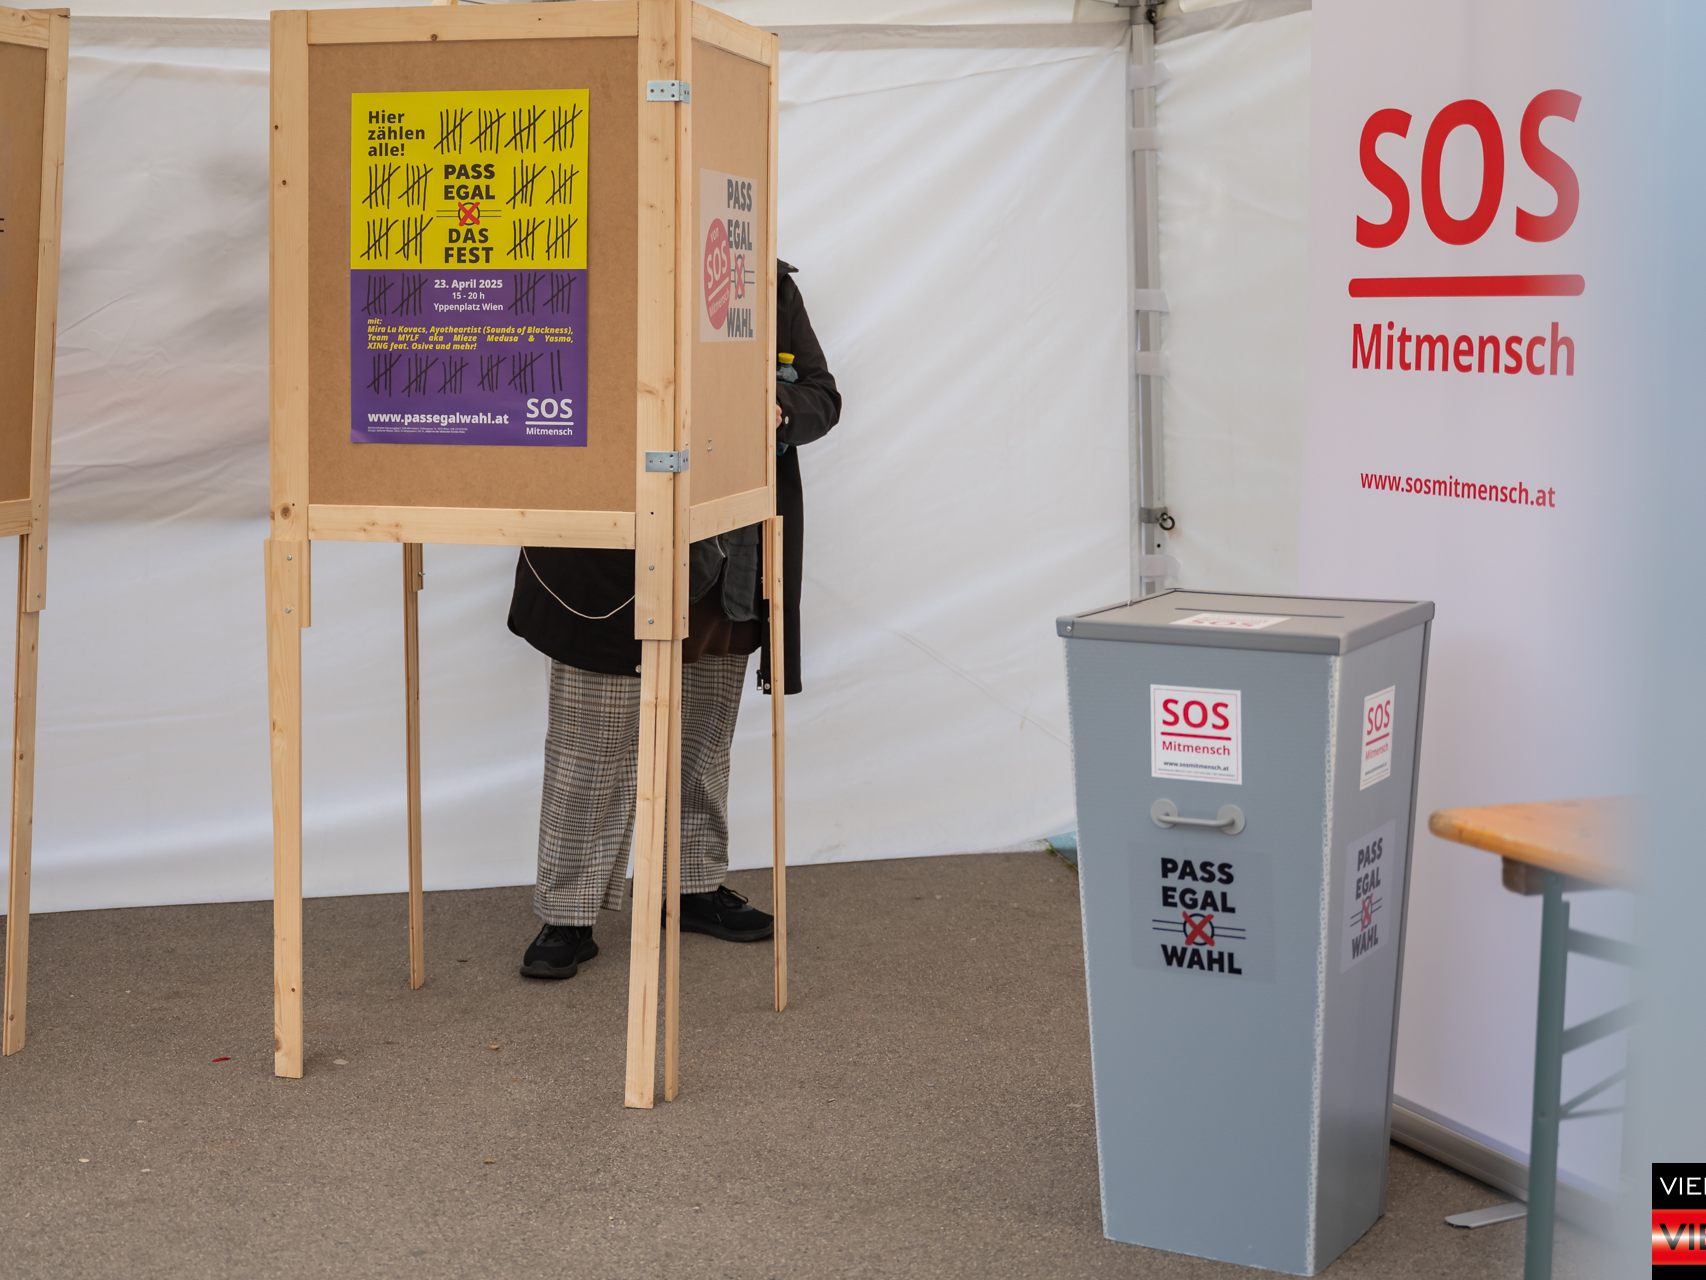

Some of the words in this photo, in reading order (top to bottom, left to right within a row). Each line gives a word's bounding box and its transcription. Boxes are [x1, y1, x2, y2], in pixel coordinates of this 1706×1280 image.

[368, 110, 405, 124] Hier
[367, 126, 425, 140] zählen
[368, 142, 405, 157] alle!
[444, 163, 496, 180] PASS
[1355, 88, 1583, 249] SOS
[443, 184, 496, 201] EGAL
[727, 178, 753, 212] PASS
[448, 228, 489, 244] DAS
[727, 219, 753, 251] EGAL
[444, 247, 494, 264] FEST
[706, 240, 728, 289] SOS
[434, 279, 449, 289] 23.
[451, 278, 477, 291] April
[479, 279, 503, 289] 2025
[452, 292, 462, 300] 15
[468, 292, 478, 300] 20
[479, 291, 485, 300] h
[433, 302, 481, 313] Yppenplatz
[482, 302, 504, 311] Wien
[398, 326, 428, 334] Kovacs,
[430, 326, 482, 335] Ayotheartist
[482, 326, 515, 335] (Sounds
[516, 326, 526, 335] of
[527, 326, 574, 335] Blackness),
[726, 307, 754, 338] WAHL
[367, 342, 389, 350] XING
[389, 342, 409, 351] feat.
[411, 342, 433, 350] Osive
[435, 342, 451, 350] und
[452, 342, 477, 350] mehr!
[397, 334, 420, 342] MYLF
[428, 334, 444, 342] aka
[453, 334, 478, 342] Mieze
[486, 334, 519, 342] Medusa
[544, 335, 574, 343] Yasmo,
[1351, 320, 1576, 377] Mitmensch
[526, 397, 573, 419] SOS
[367, 411, 510, 426] www.passegalwahl.at
[525, 427, 573, 436] Mitmensch
[1360, 471, 1556, 508] www.sosmitmensch.at
[1161, 698, 1230, 731] SOS
[1366, 699, 1391, 737] SOS
[1161, 740, 1231, 757] Mitmensch
[1356, 837, 1383, 872] PASS
[1160, 857, 1235, 885] PASS
[1355, 866, 1381, 900] EGAL
[1161, 885, 1237, 914] EGAL
[1351, 923, 1379, 960] WAHL
[1160, 943, 1243, 976] WAHL
